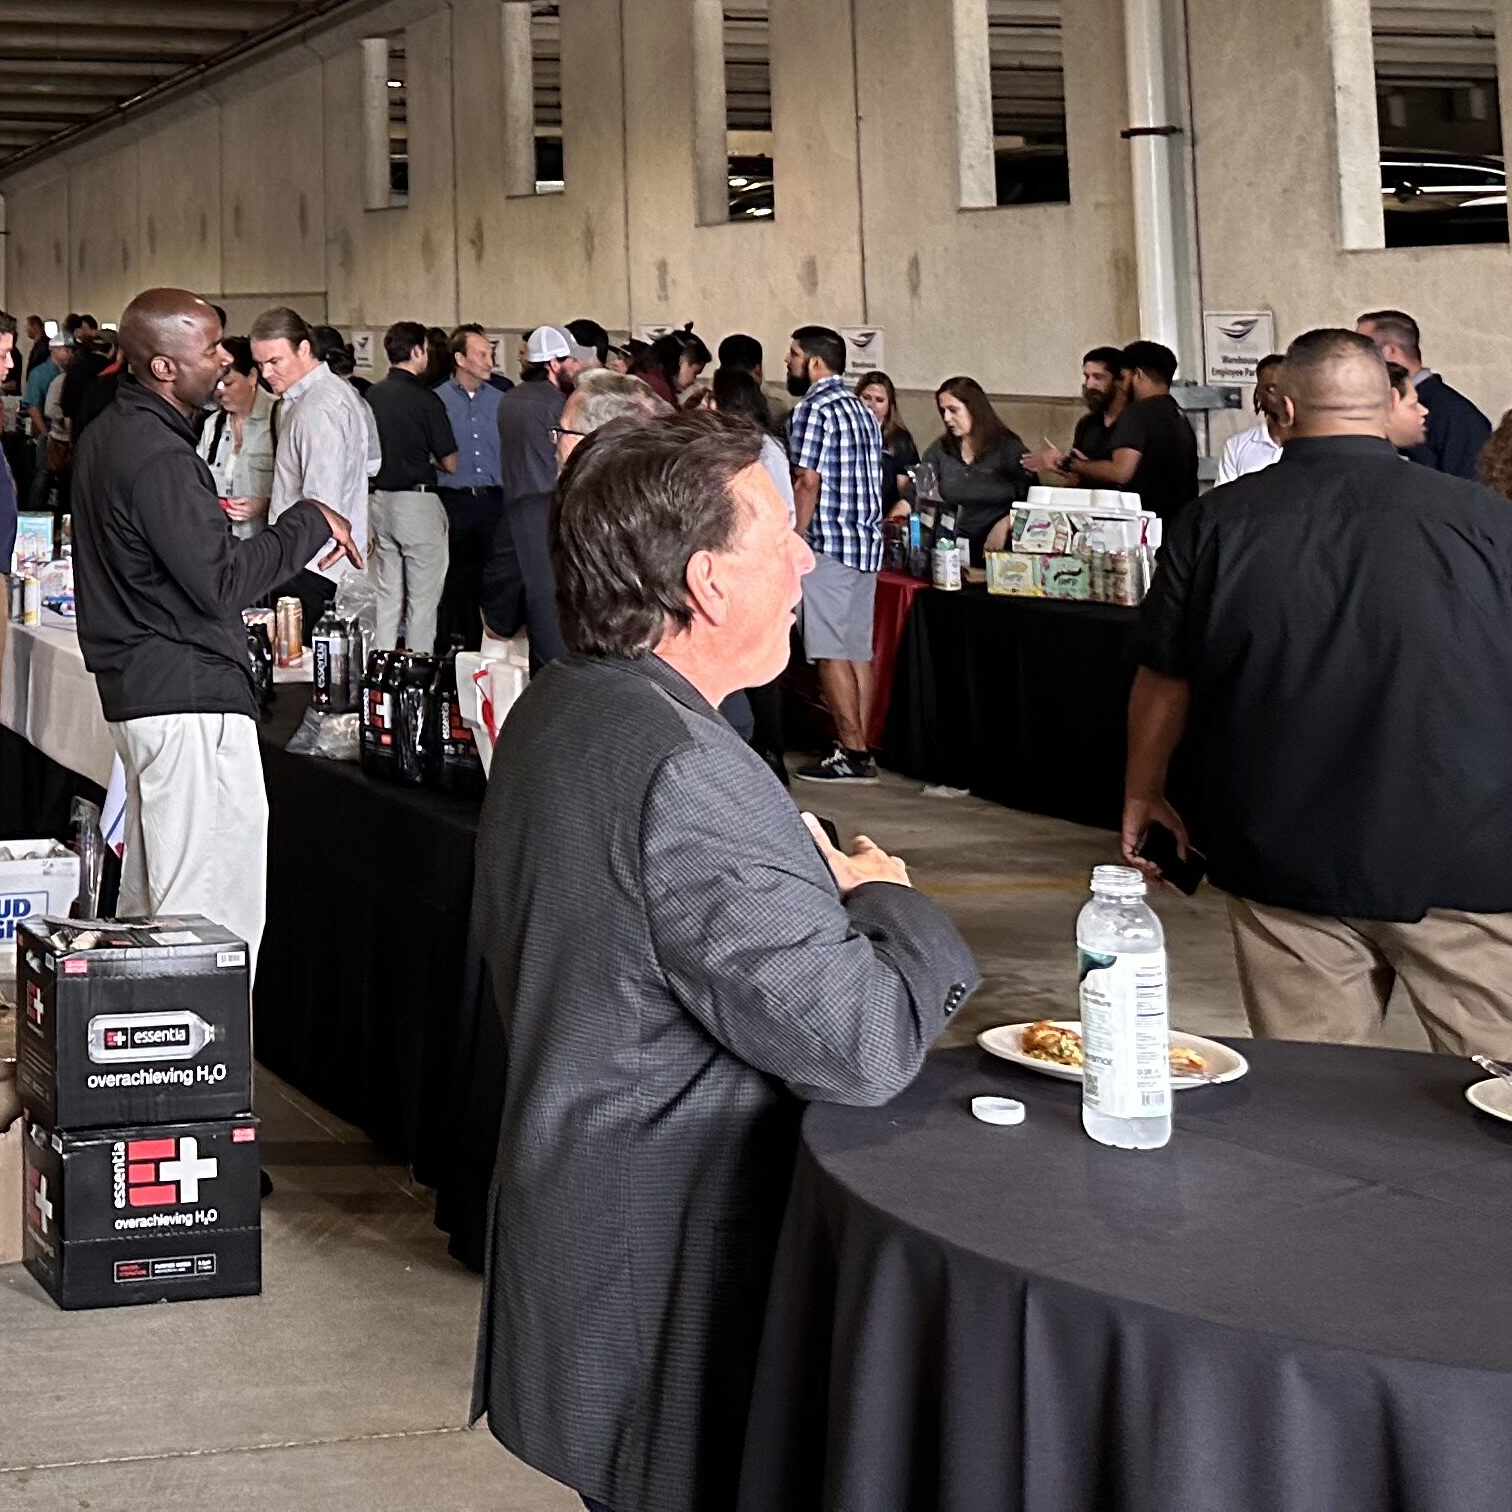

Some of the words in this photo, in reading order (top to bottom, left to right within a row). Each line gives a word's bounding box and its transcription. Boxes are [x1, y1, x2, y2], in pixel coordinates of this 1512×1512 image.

[133, 1028, 186, 1044] essentia
[87, 1066, 194, 1088] overachieving
[111, 1141, 126, 1209] essentia
[114, 1211, 194, 1230] overachieving
